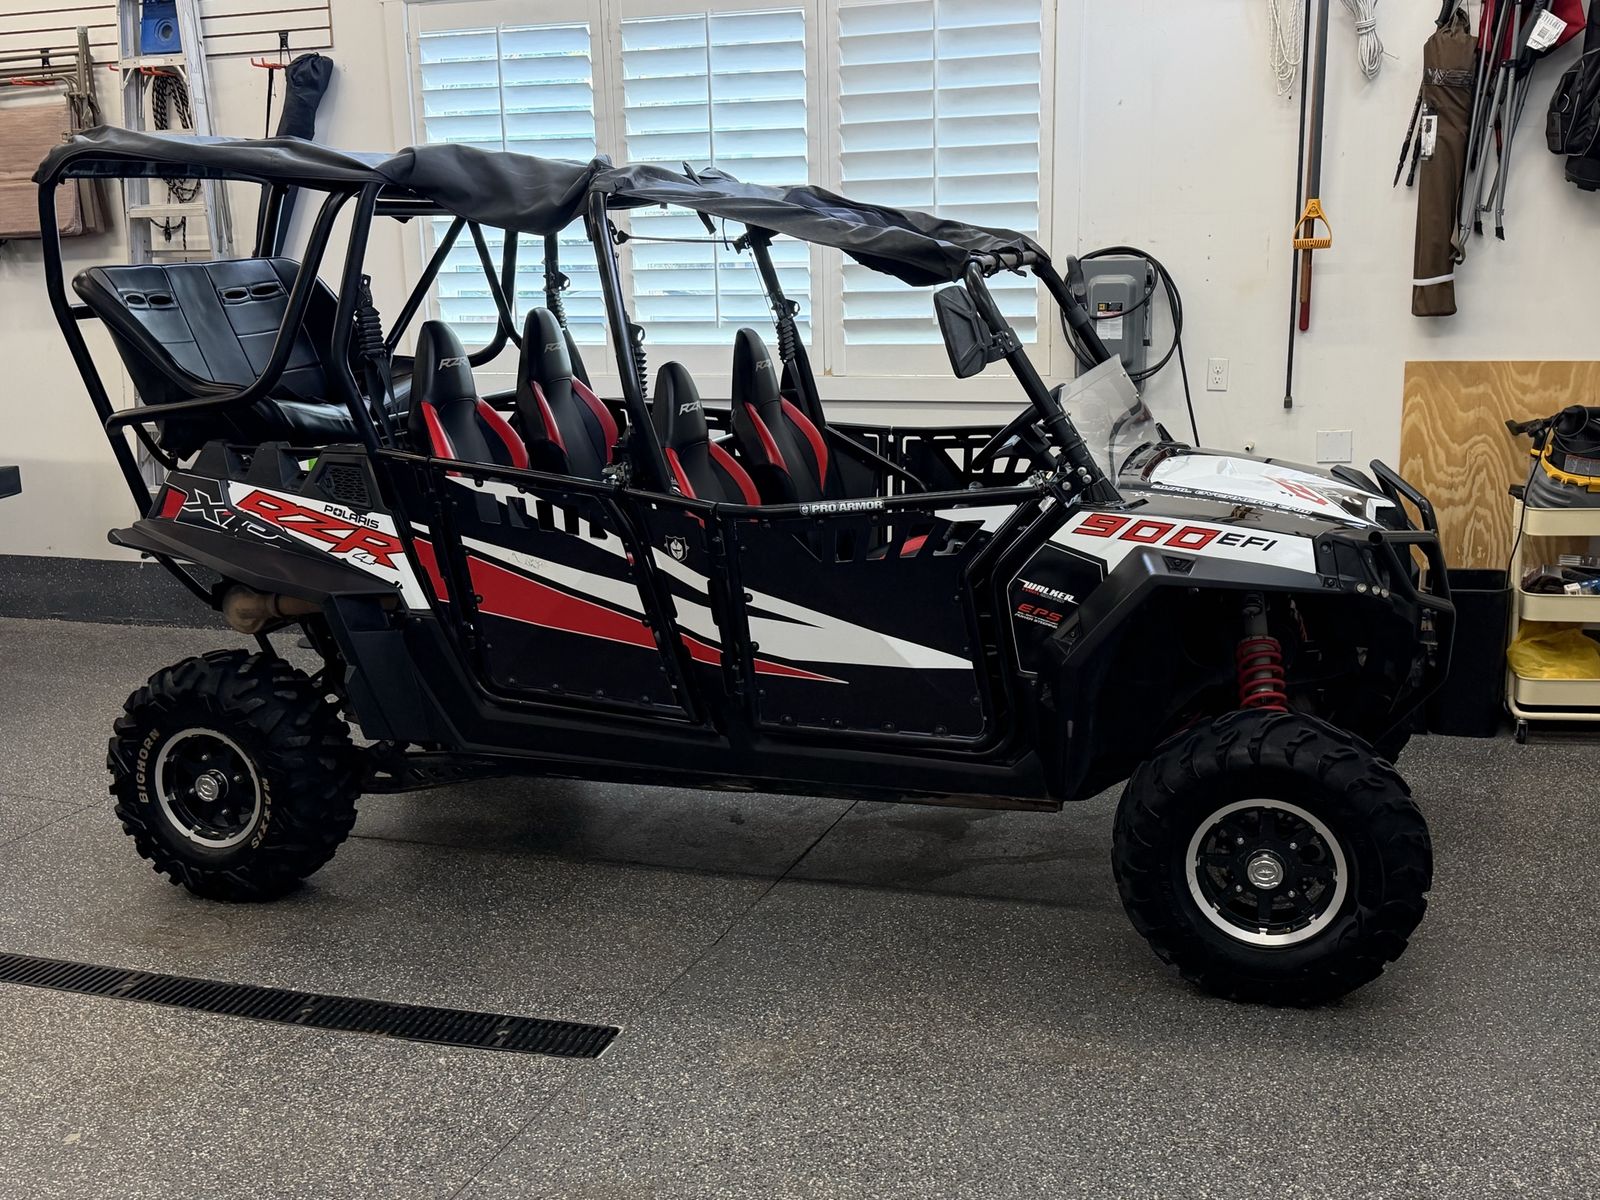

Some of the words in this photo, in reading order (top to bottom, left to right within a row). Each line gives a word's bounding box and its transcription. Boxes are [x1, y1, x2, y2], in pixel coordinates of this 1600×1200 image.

[439, 357, 470, 371] RZR
[323, 503, 380, 529] POLARIS
[811, 503, 837, 514] PRO
[838, 500, 883, 512] ARMOR
[235, 489, 404, 571] RZR
[1071, 513, 1222, 550] 900
[1216, 532, 1278, 552] EFI
[352, 552, 377, 566] 4
[1017, 577, 1079, 605] WALKER
[1018, 603, 1063, 622] EPS
[136, 728, 160, 803] BIGHORN
[251, 777, 272, 849] MAXXIS
